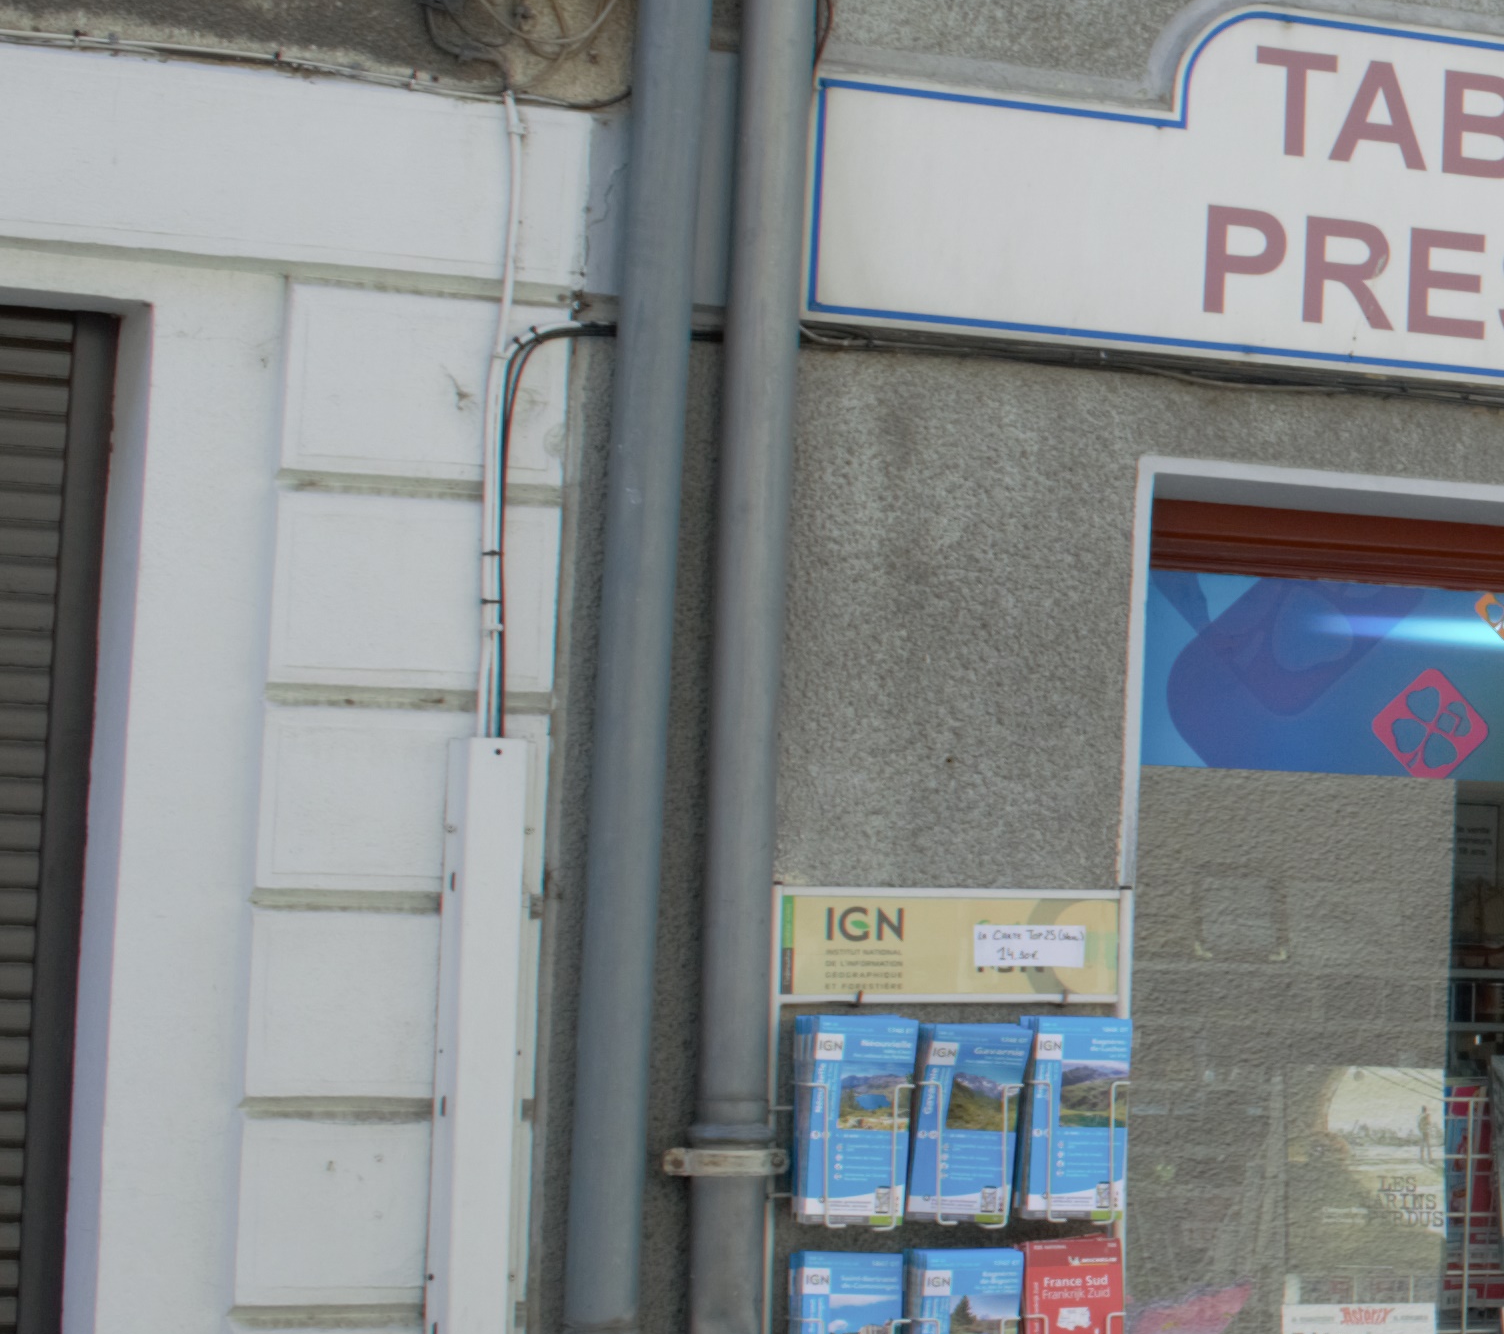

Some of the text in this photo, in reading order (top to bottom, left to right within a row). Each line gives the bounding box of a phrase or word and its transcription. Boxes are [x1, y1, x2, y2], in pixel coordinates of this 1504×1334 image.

[825, 906, 905, 942] IGN
[819, 1040, 844, 1051] IGN
[1040, 1040, 1062, 1051] IGN
[932, 1047, 956, 1057] IGN
[973, 1047, 1025, 1057] Gavarnie
[1377, 1175, 1418, 1193] LES
[1366, 1193, 1438, 1211] ARINS
[805, 1273, 829, 1284] IGN
[927, 1276, 951, 1287] IGN
[1043, 1273, 1108, 1287] France Sud
[1042, 1286, 1111, 1300] Frankrijk Zuid
[1339, 1306, 1395, 1325] Astérix
